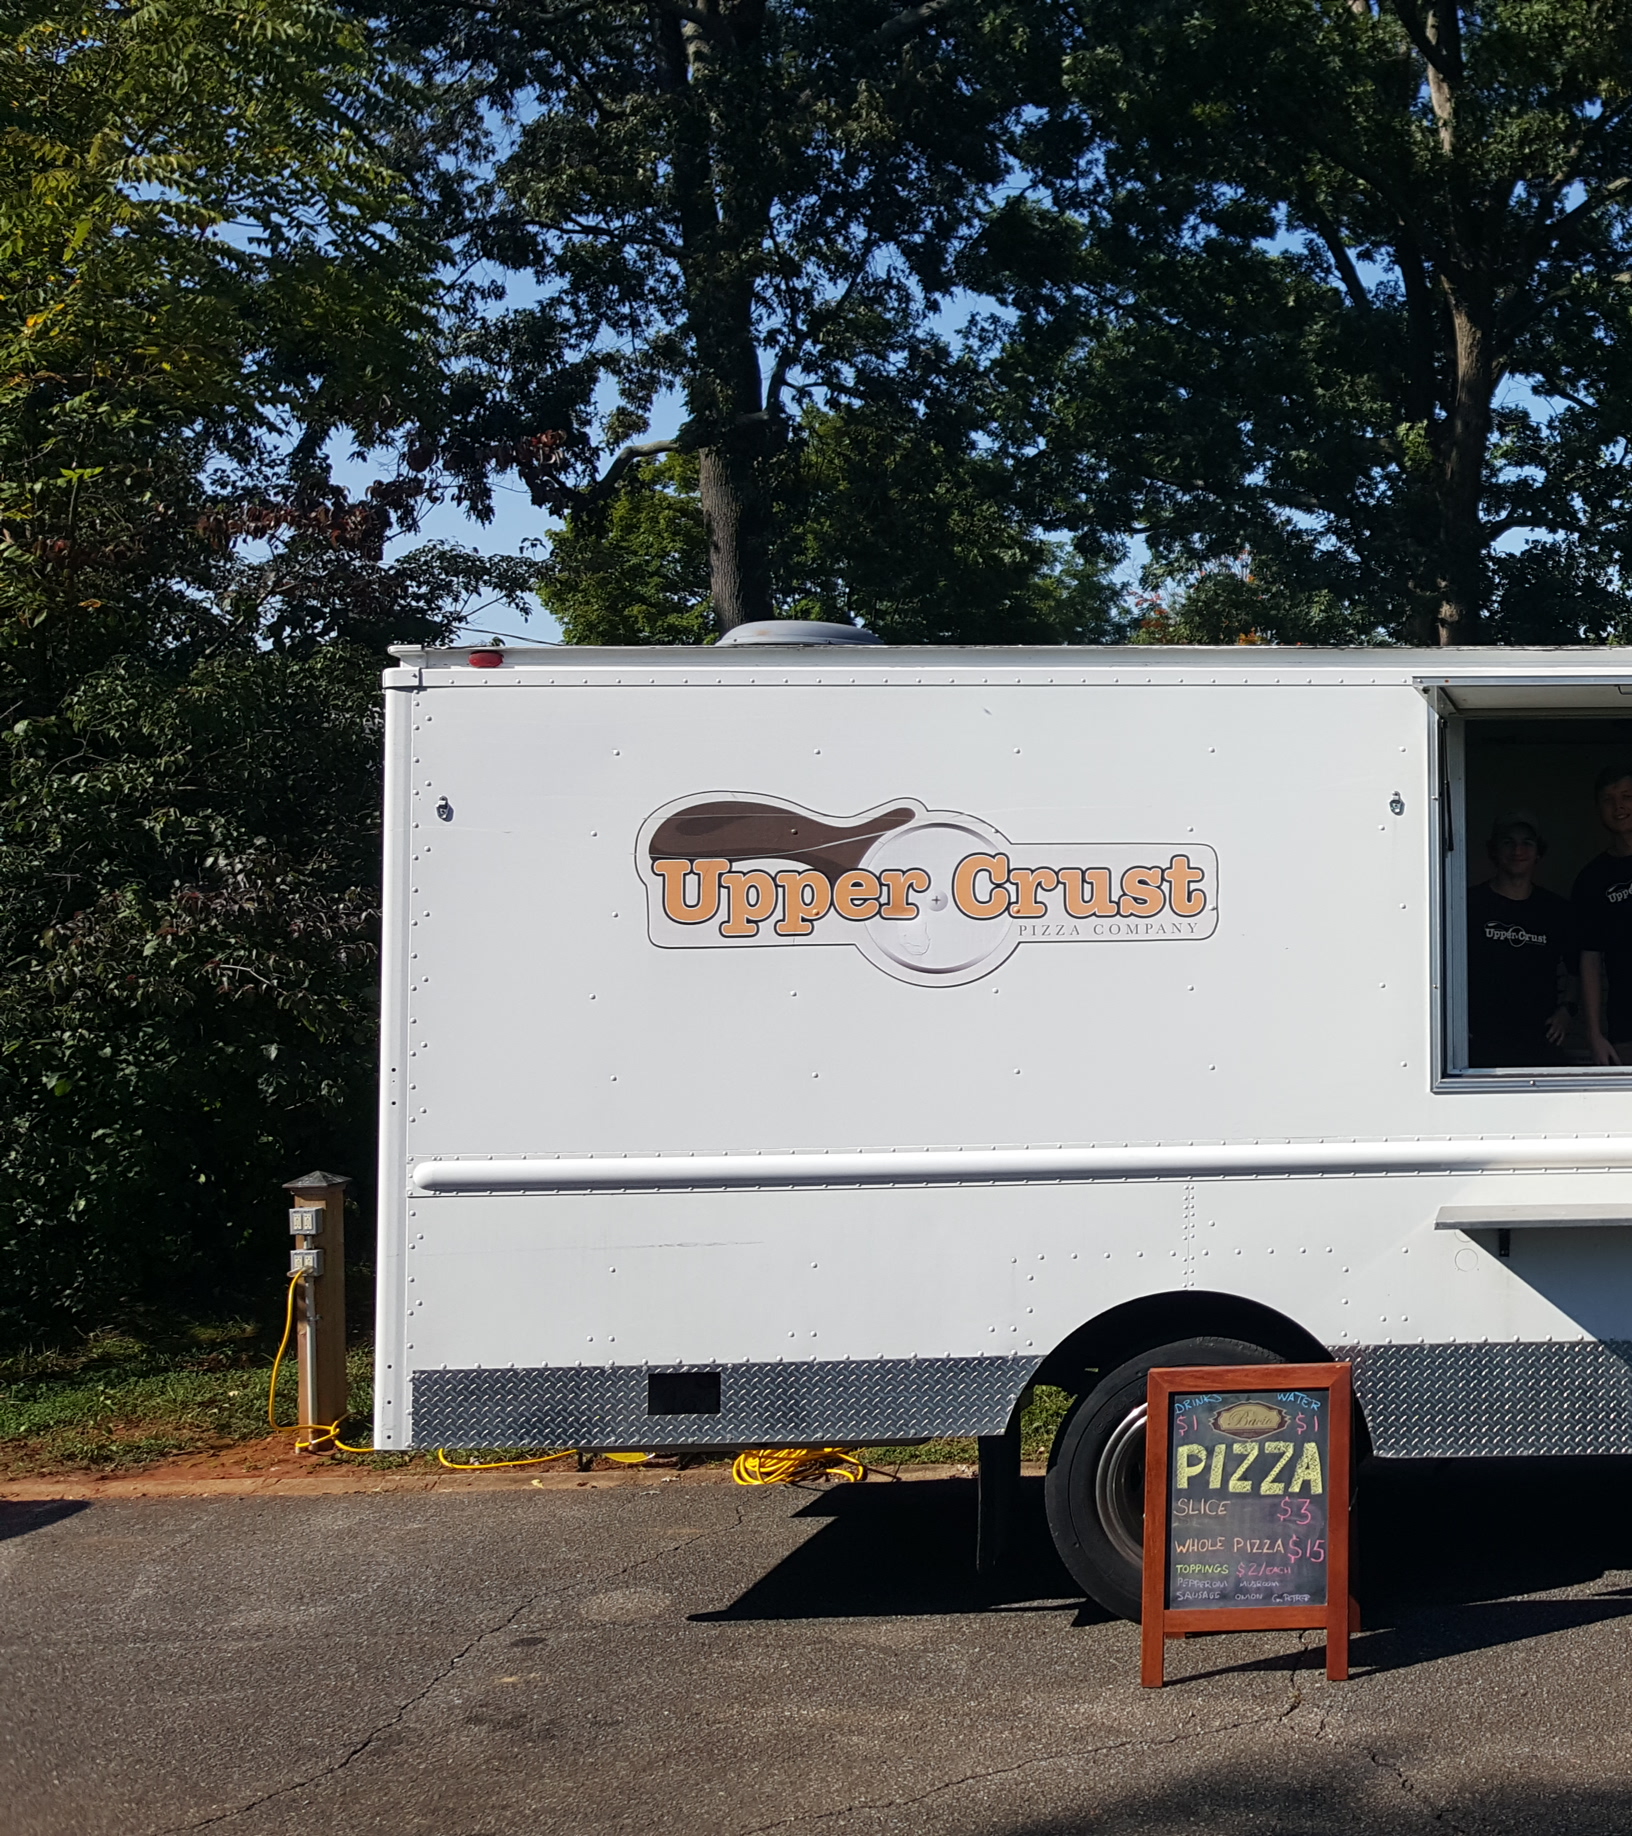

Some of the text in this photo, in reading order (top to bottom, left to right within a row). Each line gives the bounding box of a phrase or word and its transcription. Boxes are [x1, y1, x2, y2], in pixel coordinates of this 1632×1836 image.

[651, 851, 1208, 937] Upper Crust
[1018, 922, 1199, 936] PIZZA COMPANY
[1485, 928, 1547, 944] Upper Crust
[1277, 1392, 1321, 1411] WATER
[1176, 1415, 1198, 1436] $1
[1296, 1412, 1319, 1435] $1
[1177, 1441, 1323, 1495] PIZZA
[1173, 1496, 1312, 1525] SLICE $3
[1175, 1534, 1325, 1563] WHOLE PIZZA $15
[1176, 1563, 1229, 1575] TOPPINGS
[1176, 1591, 1221, 1601] SAUSAGE
